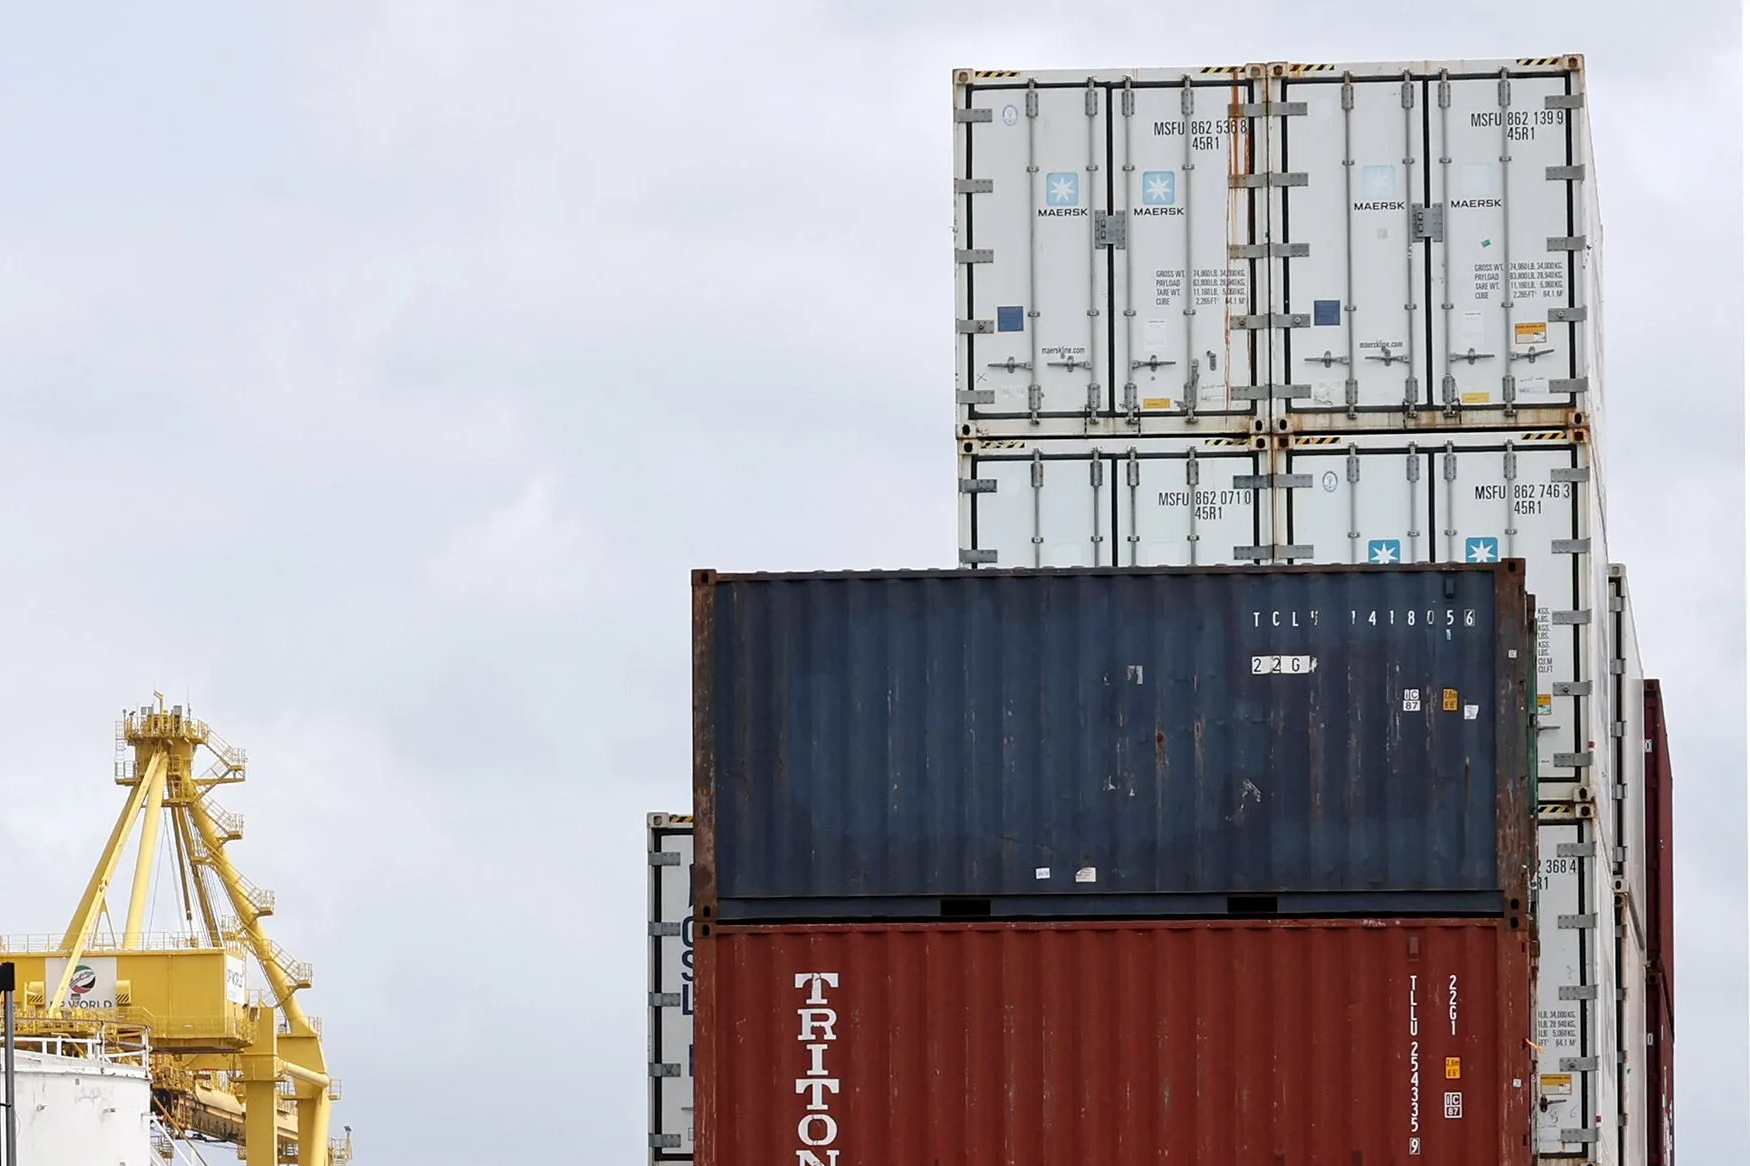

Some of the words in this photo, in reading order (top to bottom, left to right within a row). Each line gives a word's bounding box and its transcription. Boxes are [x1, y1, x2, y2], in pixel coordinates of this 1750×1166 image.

[1471, 113, 1502, 127] MSFU
[1507, 112, 1528, 126] 862
[1533, 111, 1554, 125] 139
[1556, 110, 1564, 125] 9
[1154, 122, 1185, 135] MSFU
[1191, 121, 1212, 135] 862
[1507, 127, 1535, 140] 45R1
[1192, 136, 1220, 150] 45R1
[1354, 201, 1405, 210] MAERSK
[1450, 199, 1502, 208] MAERSK
[1038, 207, 1088, 217] MAERSK
[1134, 207, 1185, 216] MAERSK
[1158, 492, 1189, 506] MSFU
[1195, 491, 1218, 505] 862
[1221, 490, 1242, 505] 071
[1245, 490, 1251, 504] 0
[1474, 485, 1506, 500] MSFU
[1513, 485, 1535, 499] 862
[1538, 484, 1560, 498] 746
[1563, 484, 1570, 498] 3
[1194, 506, 1223, 520] 45R1
[1514, 500, 1542, 514] 45R1
[1351, 610, 1454, 626] 141805
[1465, 610, 1474, 625] 6
[1404, 701, 1419, 710] 87
[1545, 860, 1567, 873] 368
[1569, 859, 1577, 873] 4
[1410, 975, 1418, 1036] TLLU
[1449, 975, 1457, 1035] 22G1
[1410, 1042, 1419, 1132] 254335
[1448, 1108, 1458, 1116] 87
[1411, 1138, 1419, 1153] 9
